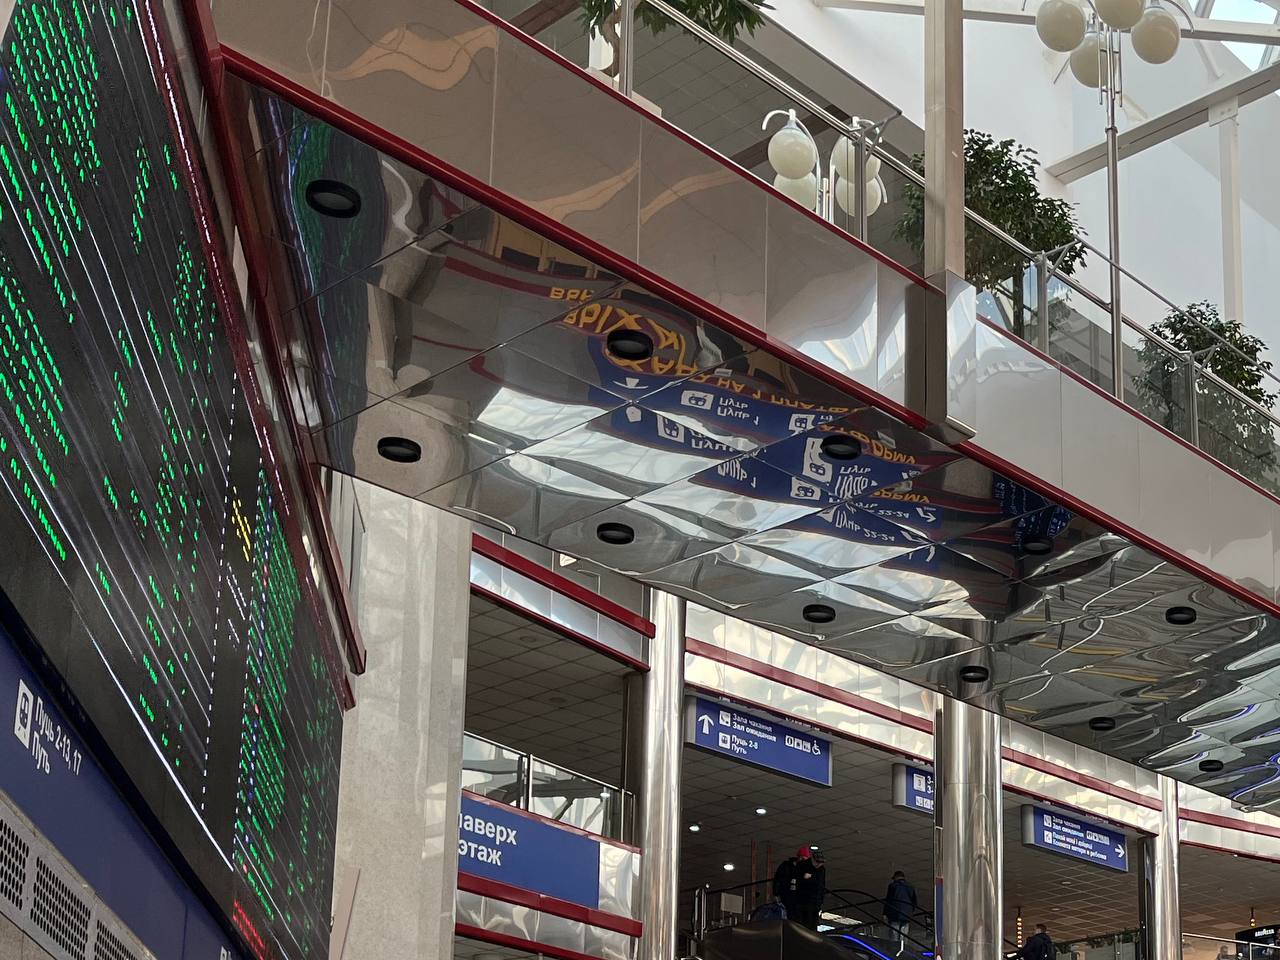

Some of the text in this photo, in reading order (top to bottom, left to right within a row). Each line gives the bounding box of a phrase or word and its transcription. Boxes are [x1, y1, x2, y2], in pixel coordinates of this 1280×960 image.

[35, 696, 55, 743] Пуць
[73, 749, 82, 776] 17
[731, 735, 748, 748] Пуць
[732, 721, 777, 742] Зал ожидания
[31, 731, 51, 774] Путь
[731, 744, 748, 755] Путь
